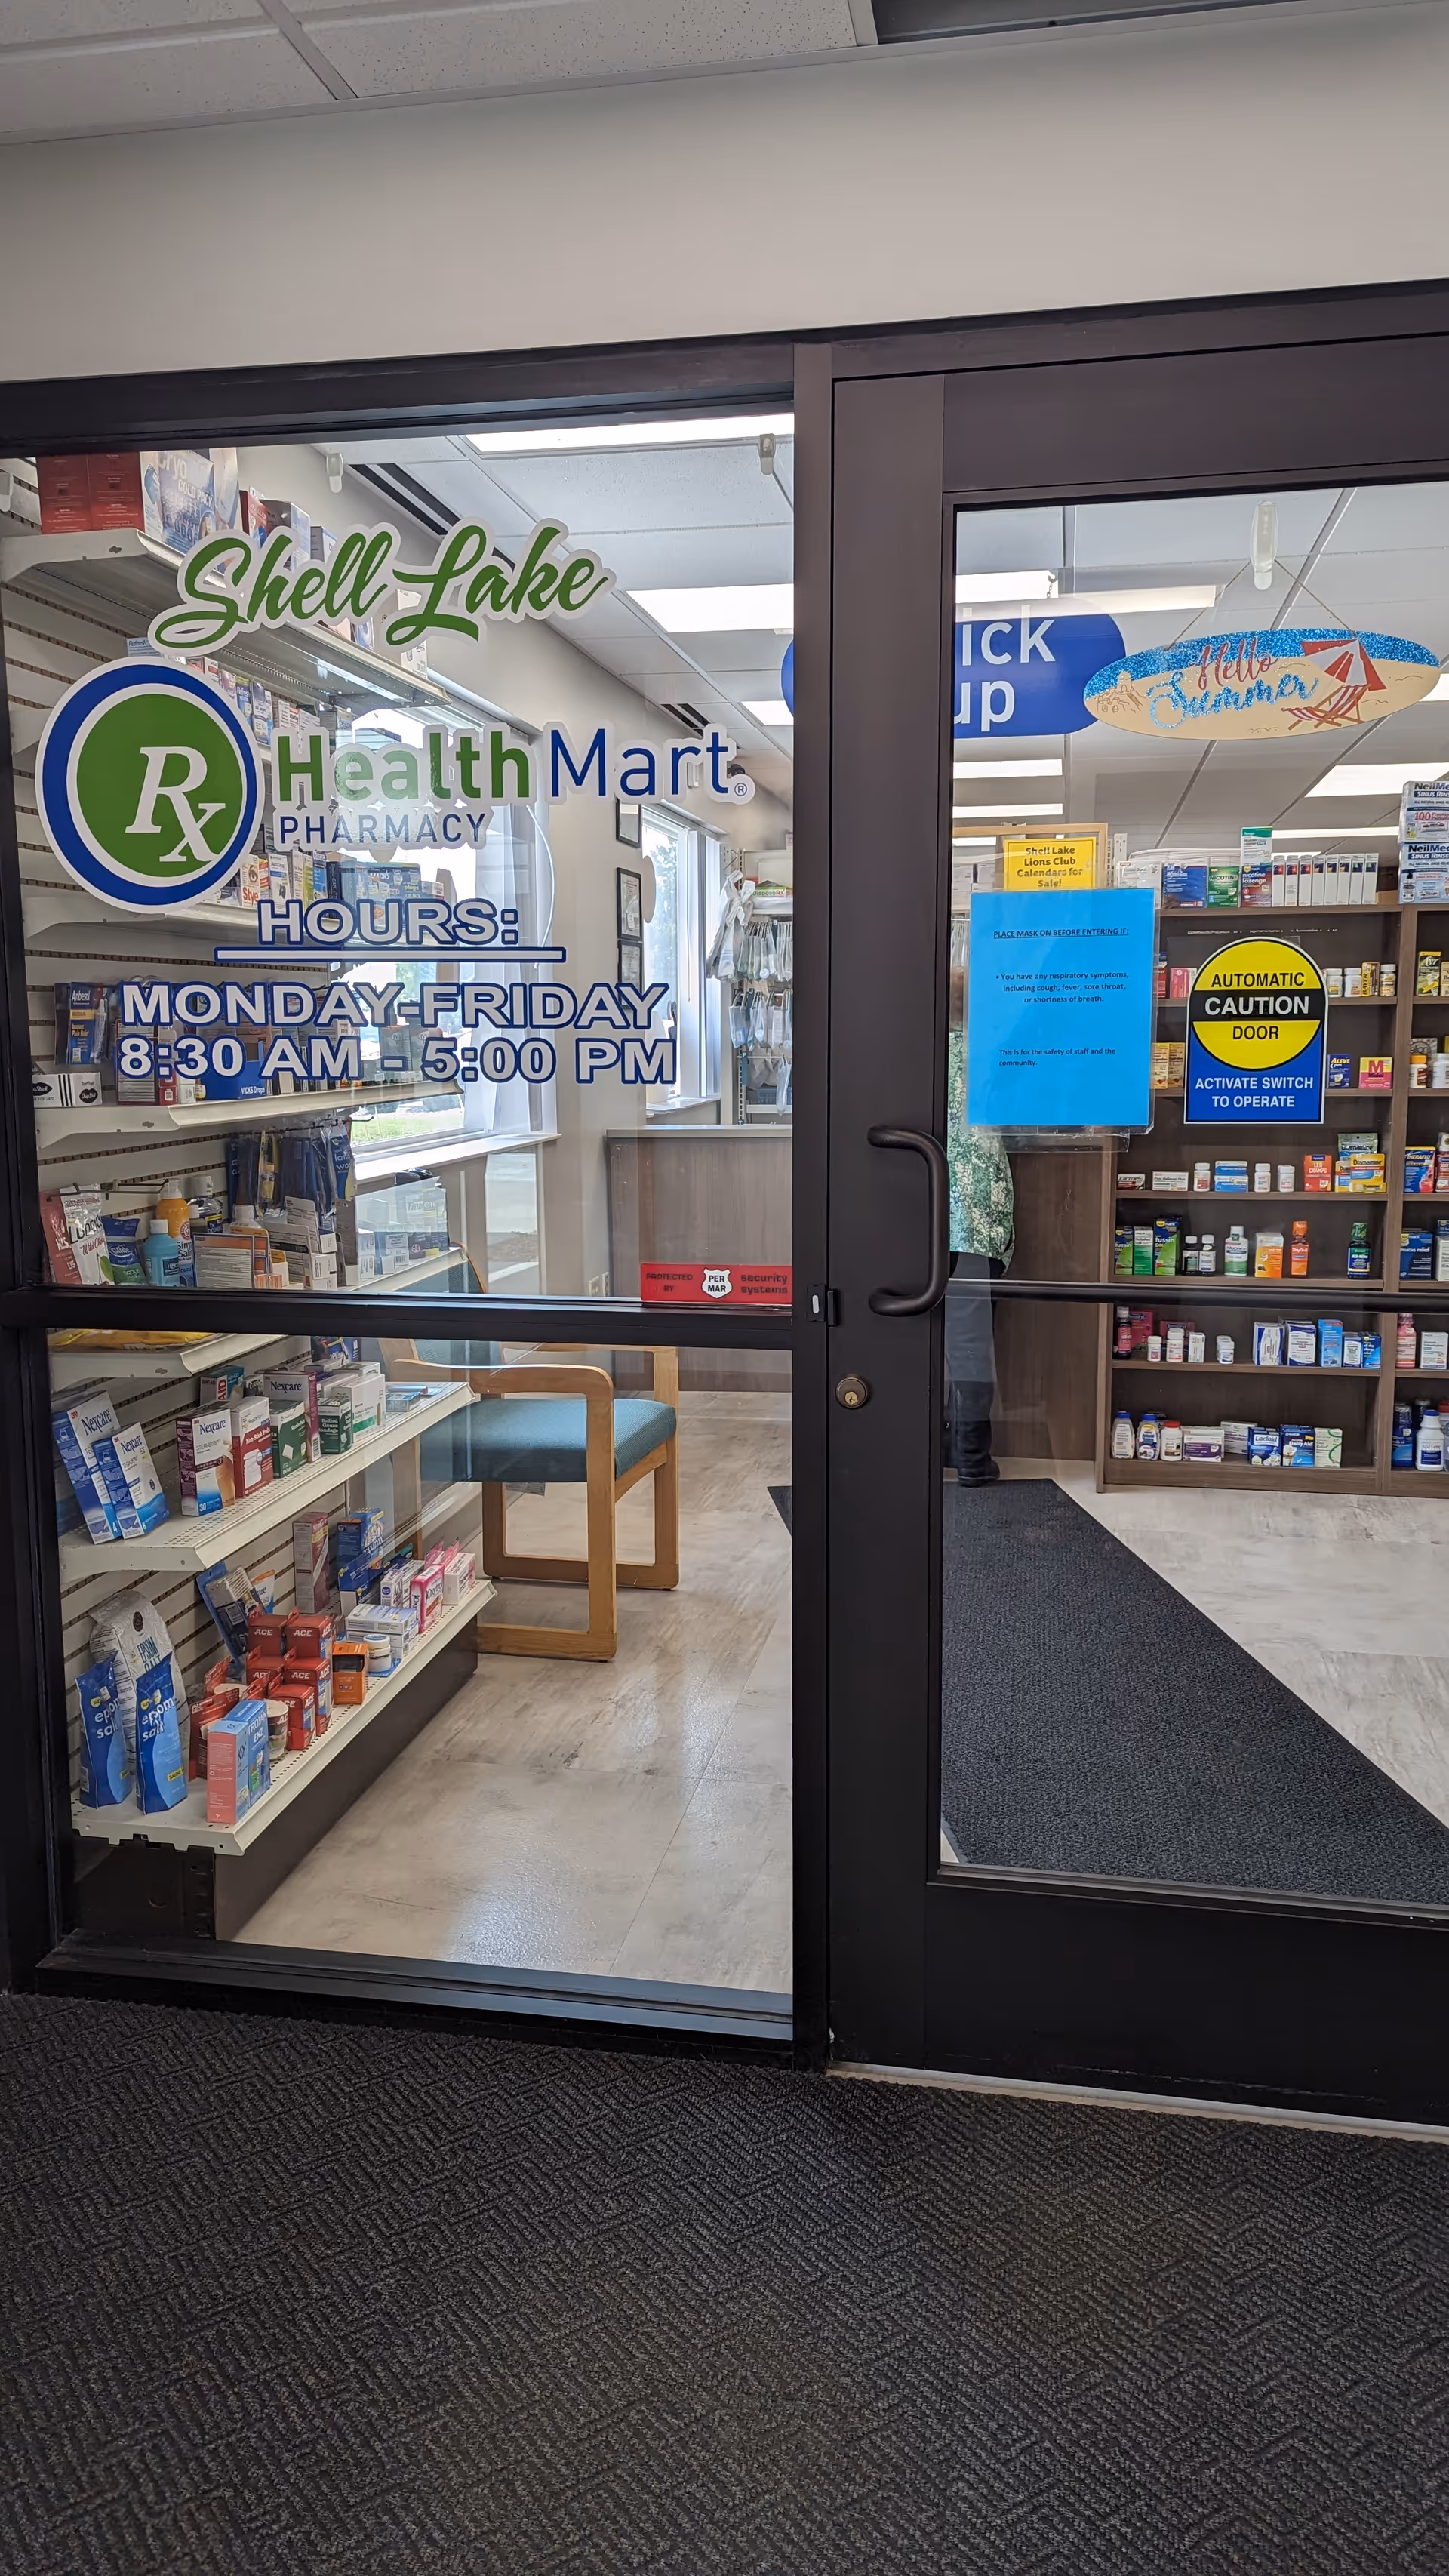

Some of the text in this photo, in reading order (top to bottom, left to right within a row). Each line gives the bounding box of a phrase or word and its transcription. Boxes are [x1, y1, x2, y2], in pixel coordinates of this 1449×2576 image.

[178, 479, 214, 509] COLD PACK
[155, 525, 608, 648] Shell Lake
[961, 605, 1056, 666] ick
[1190, 637, 1278, 691] Hello
[1146, 671, 1319, 729] Summer
[277, 730, 529, 802] Health
[1414, 782, 1449, 790] NeilMe
[125, 746, 226, 862] Rx
[1414, 812, 1432, 820] 100
[280, 812, 485, 845] PHARMACY
[1026, 846, 1075, 855] Shell Lake
[1023, 857, 1076, 866] Lions Club
[1017, 869, 1067, 878] Calendars
[1038, 879, 1062, 888] Sale!
[242, 886, 259, 904] Stye
[258, 898, 519, 946] HOURS:
[993, 930, 1015, 938] PLACE
[1082, 928, 1118, 936] ENTERING
[1211, 972, 1305, 988] AUTOMATIC
[1003, 984, 1035, 993] including
[1037, 983, 1060, 993] cough,
[1101, 983, 1126, 991] throat,
[121, 982, 670, 1030] MONDAY-FRIDAY
[1204, 996, 1309, 1016] CAUTION
[1232, 1026, 1279, 1040] DOOR
[118, 1033, 246, 1080] 8:30
[258, 1034, 361, 1080] AM
[421, 1037, 556, 1084] 5:00
[575, 1037, 677, 1084] PM
[998, 1048, 1011, 1056] This
[1044, 1048, 1063, 1057] safety
[1065, 1047, 1072, 1055] of
[998, 1059, 1038, 1067] community.
[241, 1086, 252, 1094] VICKS
[1195, 1077, 1314, 1090] ACTIVATE SWITCH
[1211, 1095, 1295, 1108] TO OPERATE
[741, 1273, 787, 1284] security
[741, 1285, 788, 1295] systems
[218, 1379, 226, 1400] AID
[270, 1381, 302, 1393] Nexcare
[71, 1410, 79, 1420] 3M
[81, 1408, 112, 1436] Nexcare
[199, 1420, 227, 1435] Nexcare
[120, 1435, 143, 1454] Nexcare
[199, 1503, 207, 1512] 30
[322, 1623, 331, 1637] ACE
[137, 1636, 159, 1662] EPSOM
[319, 1664, 331, 1680] ACE
[305, 1692, 315, 1708] ACE
[248, 1710, 267, 1736] TROJAN
